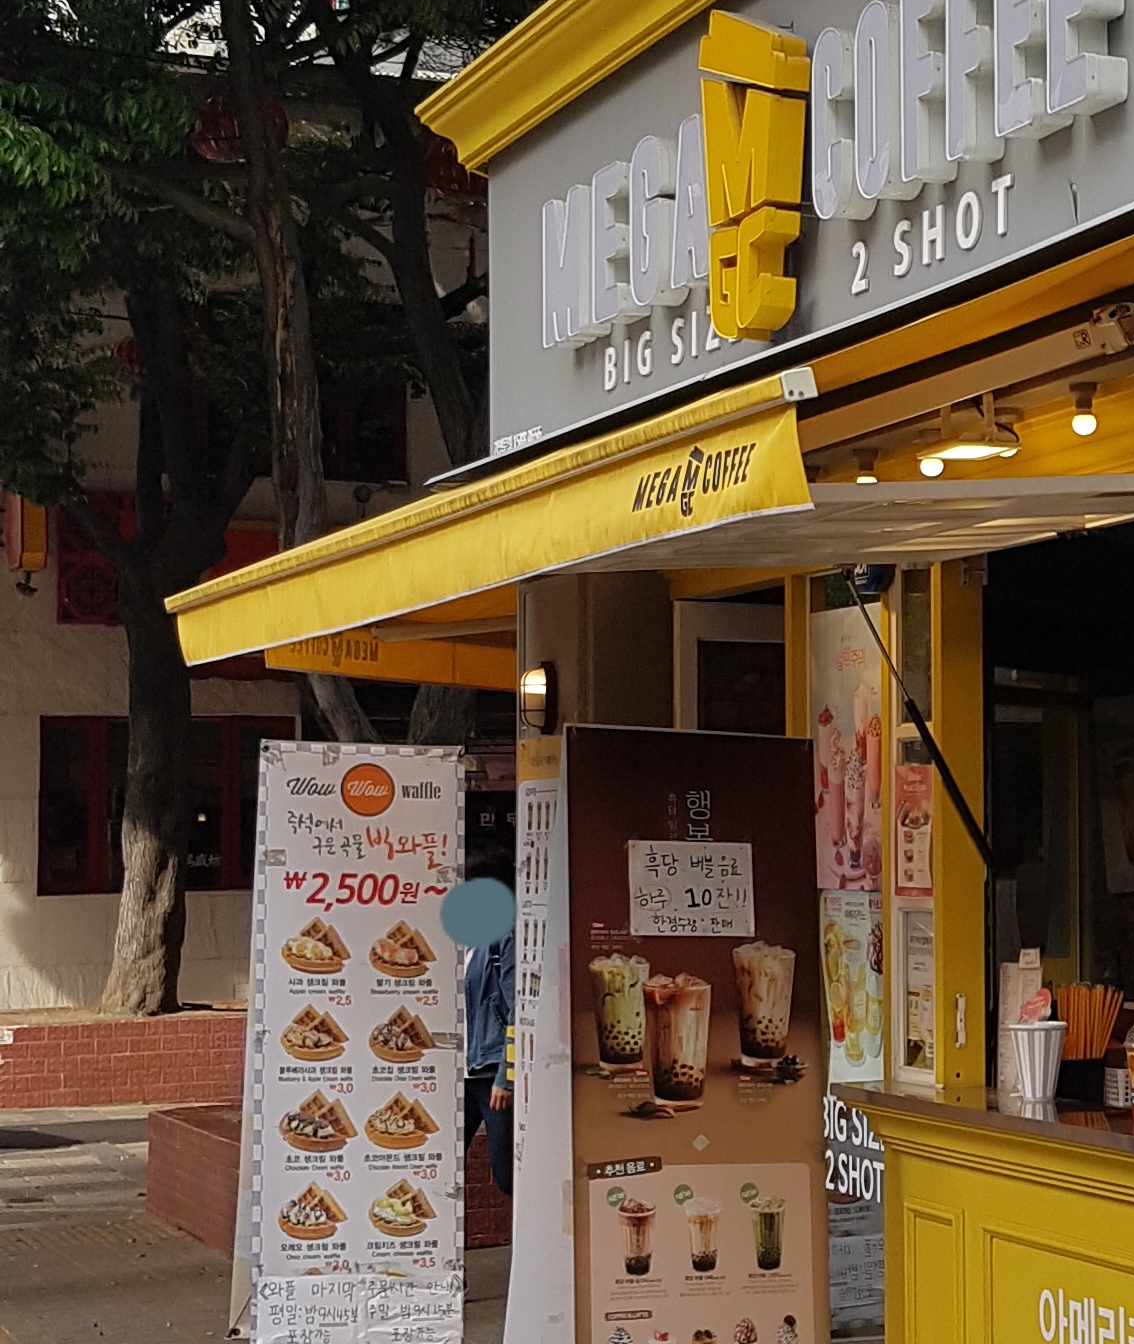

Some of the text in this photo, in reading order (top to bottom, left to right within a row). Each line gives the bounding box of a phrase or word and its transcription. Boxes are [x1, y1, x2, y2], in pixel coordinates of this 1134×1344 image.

[542, 113, 710, 349] MEGA
[851, 173, 1014, 295] 2 SHOT
[604, 305, 742, 392] BIG SIZ
[632, 465, 682, 513] MEGA
[702, 443, 757, 495] COFFEE
[287, 777, 441, 799] Wow Wow waffle
[287, 811, 343, 834] 즉석에서
[312, 836, 336, 856] 구운
[645, 845, 679, 878] 흑당
[634, 887, 668, 909] 하루
[825, 1149, 885, 1203] 2 SHOT
[311, 1281, 356, 1302] 마지막
